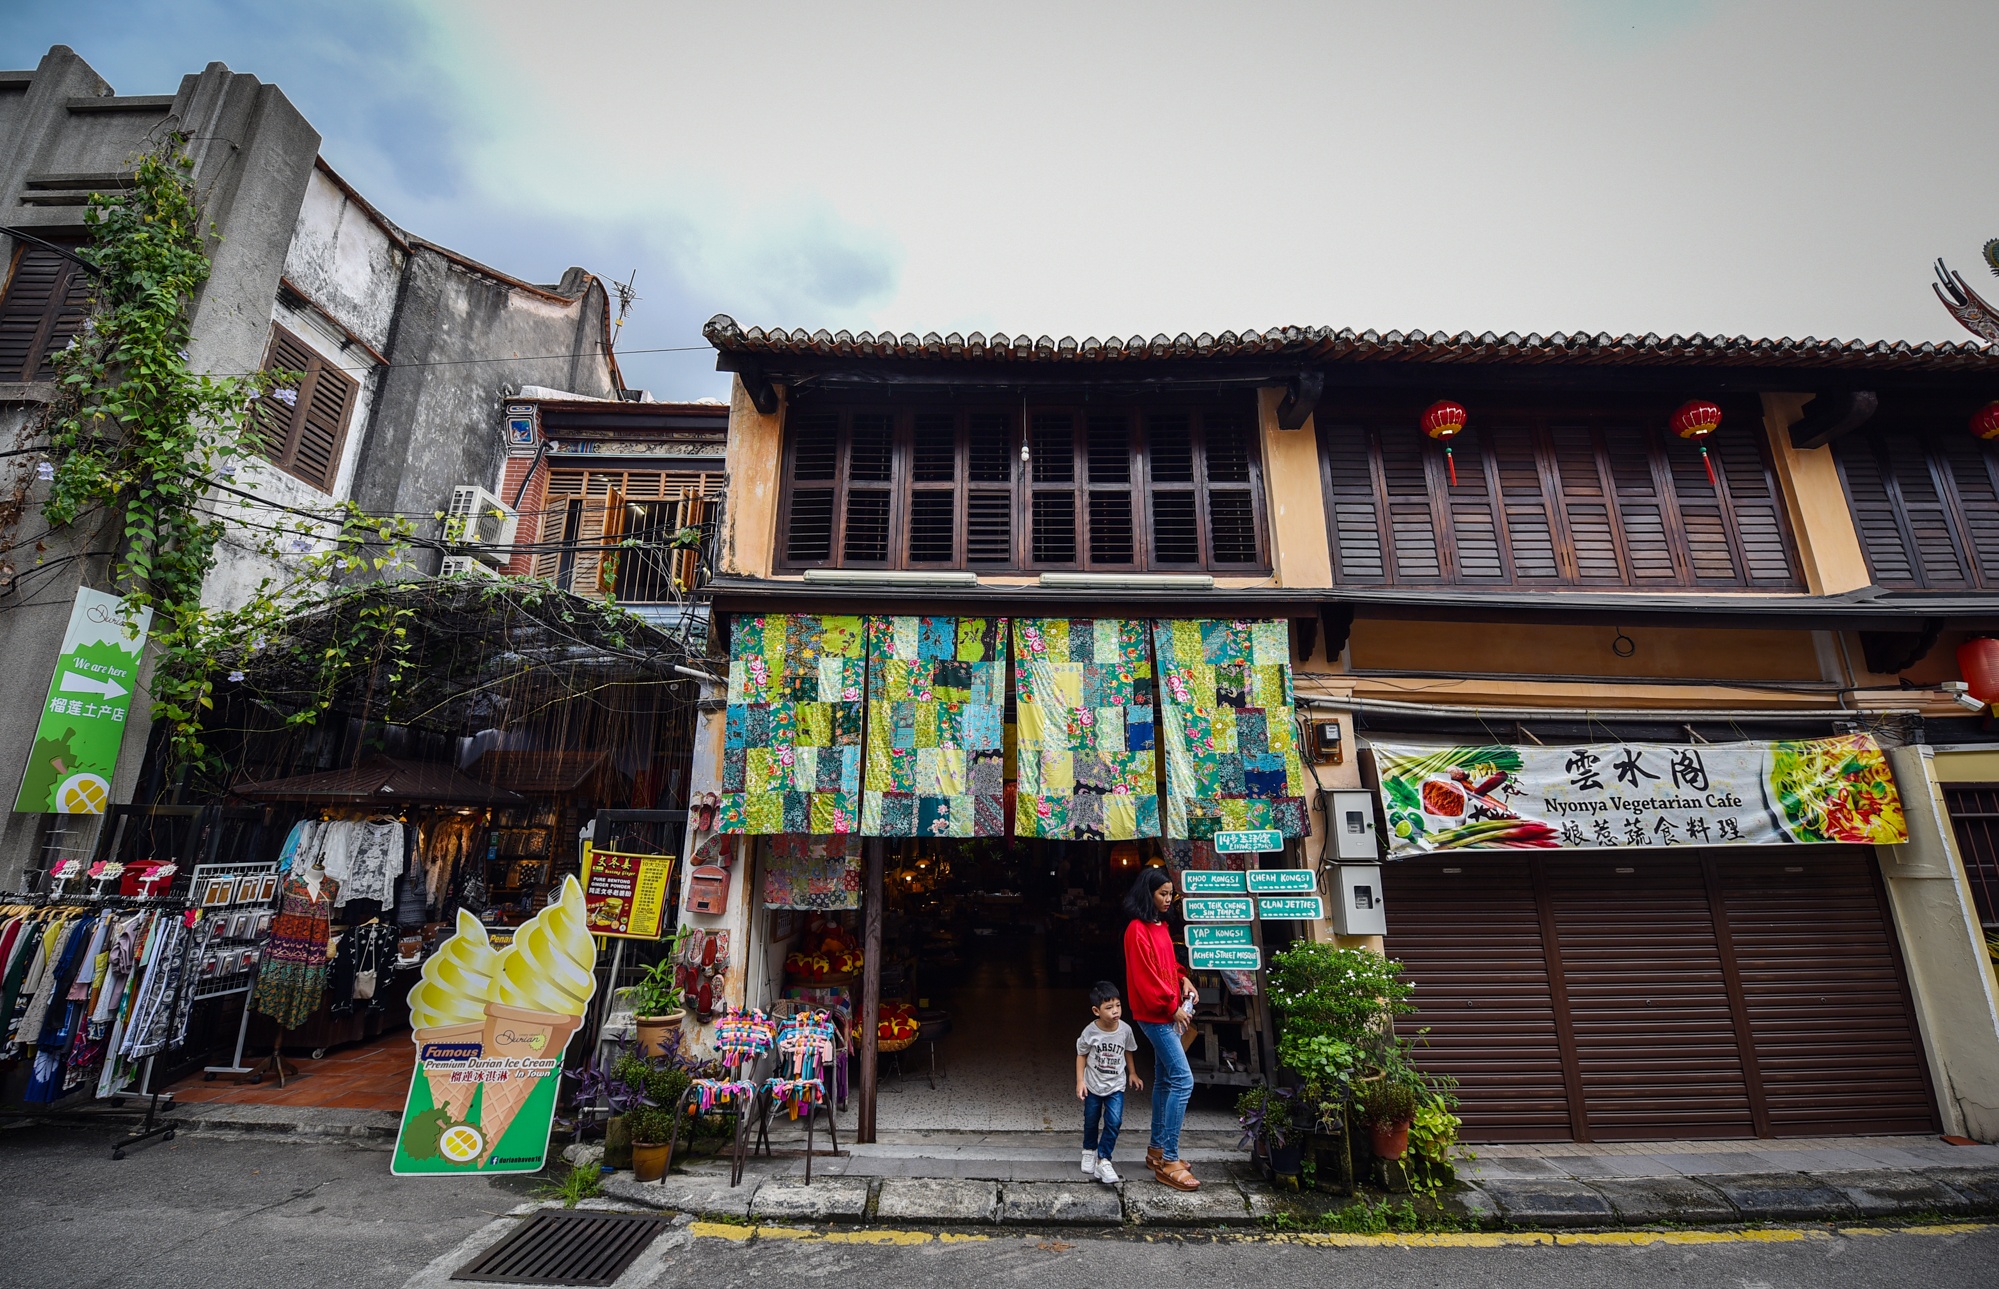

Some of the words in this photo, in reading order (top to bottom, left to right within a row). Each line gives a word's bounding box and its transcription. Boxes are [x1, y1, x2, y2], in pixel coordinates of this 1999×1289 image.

[73, 657, 89, 670] We
[91, 664, 107, 673] are
[108, 665, 127, 678] here
[49, 696, 125, 722] 榴莲土产店
[1544, 798, 1608, 816] Nyonya
[1609, 794, 1703, 816] Vegetarian
[1705, 792, 1743, 808] Cafe
[1560, 815, 1746, 847] 娘惹蔬食料理
[1187, 875, 1206, 883] KHOO
[1211, 875, 1239, 883] KONGSI
[1251, 873, 1276, 882] CHEAH
[1281, 873, 1310, 882] KONGSI
[1188, 902, 1205, 910] HOCK
[1207, 902, 1223, 910] TEIK
[1224, 902, 1246, 910] CHENG
[1261, 900, 1283, 909] CLAN
[1284, 900, 1316, 909] JETTIES
[490, 934, 513, 943] Penan
[1192, 929, 1210, 938] YAP
[1215, 929, 1243, 937] KONGSI
[1193, 951, 1214, 959] ACHEH
[1216, 950, 1236, 959] STREET
[1236, 951, 1257, 960] MOSQUE
[495, 1030, 541, 1045] Durian
[425, 1046, 479, 1058] Famous
[425, 1060, 466, 1069] Premium
[468, 1058, 503, 1068] Durian
[504, 1059, 519, 1068] Ice
[521, 1058, 555, 1068] Cream
[516, 1070, 525, 1078] In
[527, 1070, 551, 1078] Town
